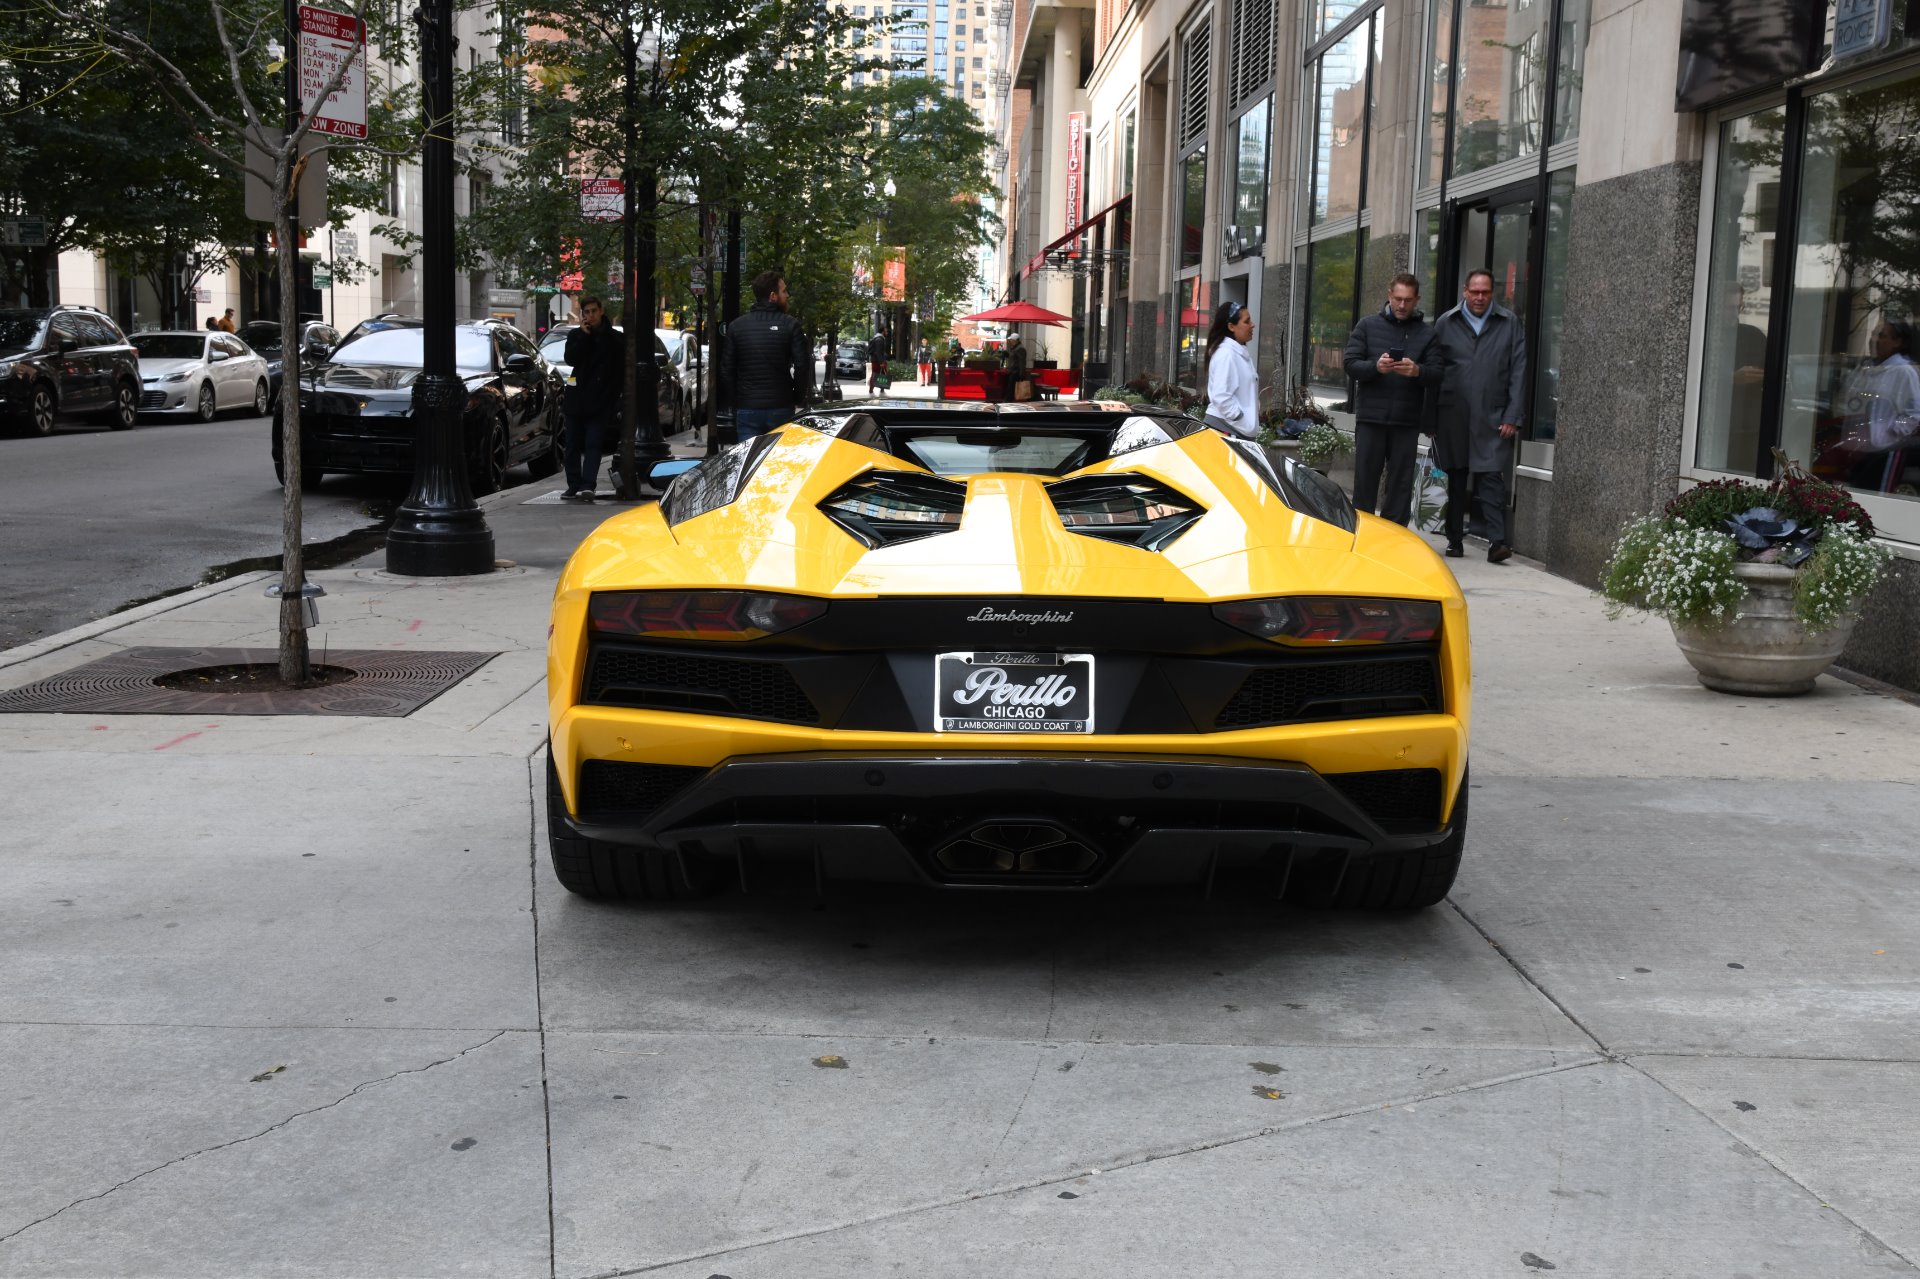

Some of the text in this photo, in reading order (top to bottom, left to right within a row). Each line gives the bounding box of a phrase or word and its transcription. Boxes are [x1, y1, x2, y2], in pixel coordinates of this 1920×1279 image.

[303, 9, 339, 26] 15 MINUTE
[303, 20, 355, 39] STANDING ZON
[1838, 17, 1875, 47] ROYCE
[303, 37, 318, 47] USE
[303, 47, 338, 62] FLASHING
[303, 57, 311, 67] 10
[312, 59, 324, 70] AM
[331, 62, 336, 72] 8
[303, 68, 320, 79] MON
[303, 78, 311, 87] 10
[312, 80, 323, 90] AM
[303, 88, 338, 103] FRI UN
[311, 117, 361, 136] OW ZONE
[1069, 118, 1080, 171] EPIC
[966, 606, 1074, 625] Lamborghini
[990, 653, 1040, 664] Perillo
[953, 667, 1077, 707] Perillo
[983, 705, 1046, 719] CHICAGO
[958, 721, 1070, 731] LAMBORGHINI GOLD COAST
